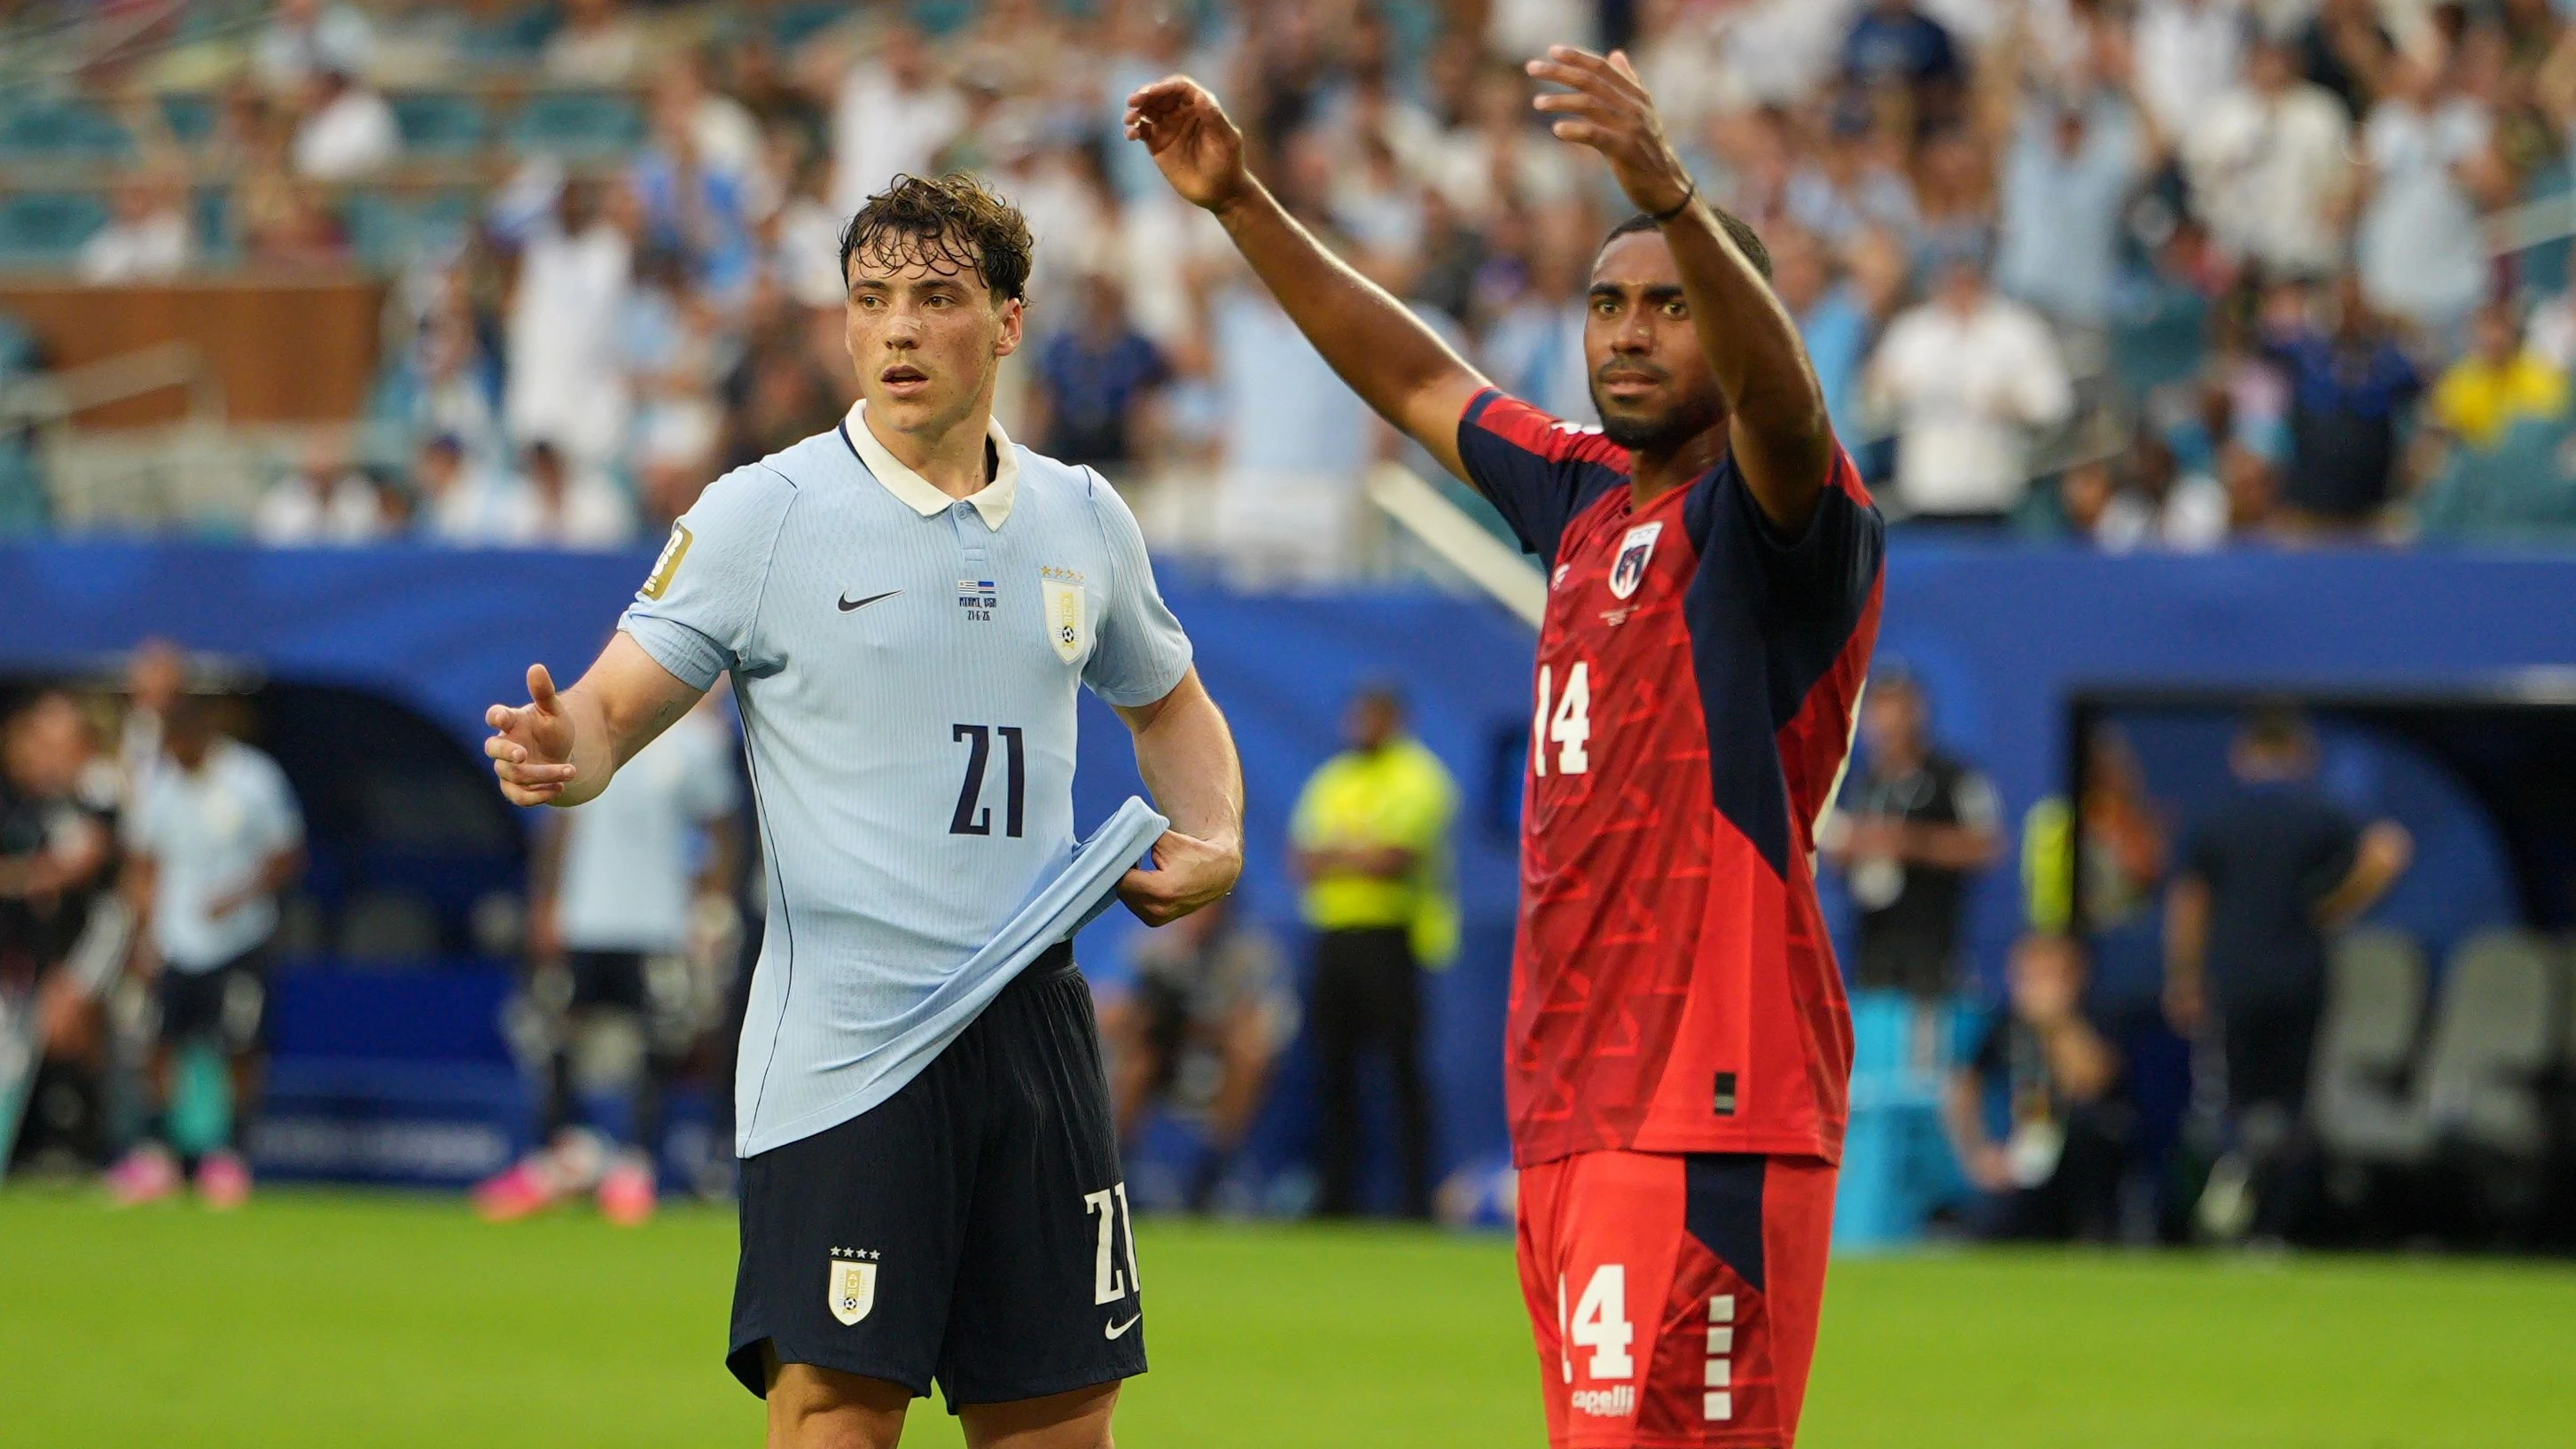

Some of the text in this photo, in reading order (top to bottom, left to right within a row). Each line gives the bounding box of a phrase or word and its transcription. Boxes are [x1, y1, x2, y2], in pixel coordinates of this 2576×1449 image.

[1534, 661, 1590, 777] 14
[949, 723, 1025, 838] 21
[1084, 1181, 1140, 1305] 21
